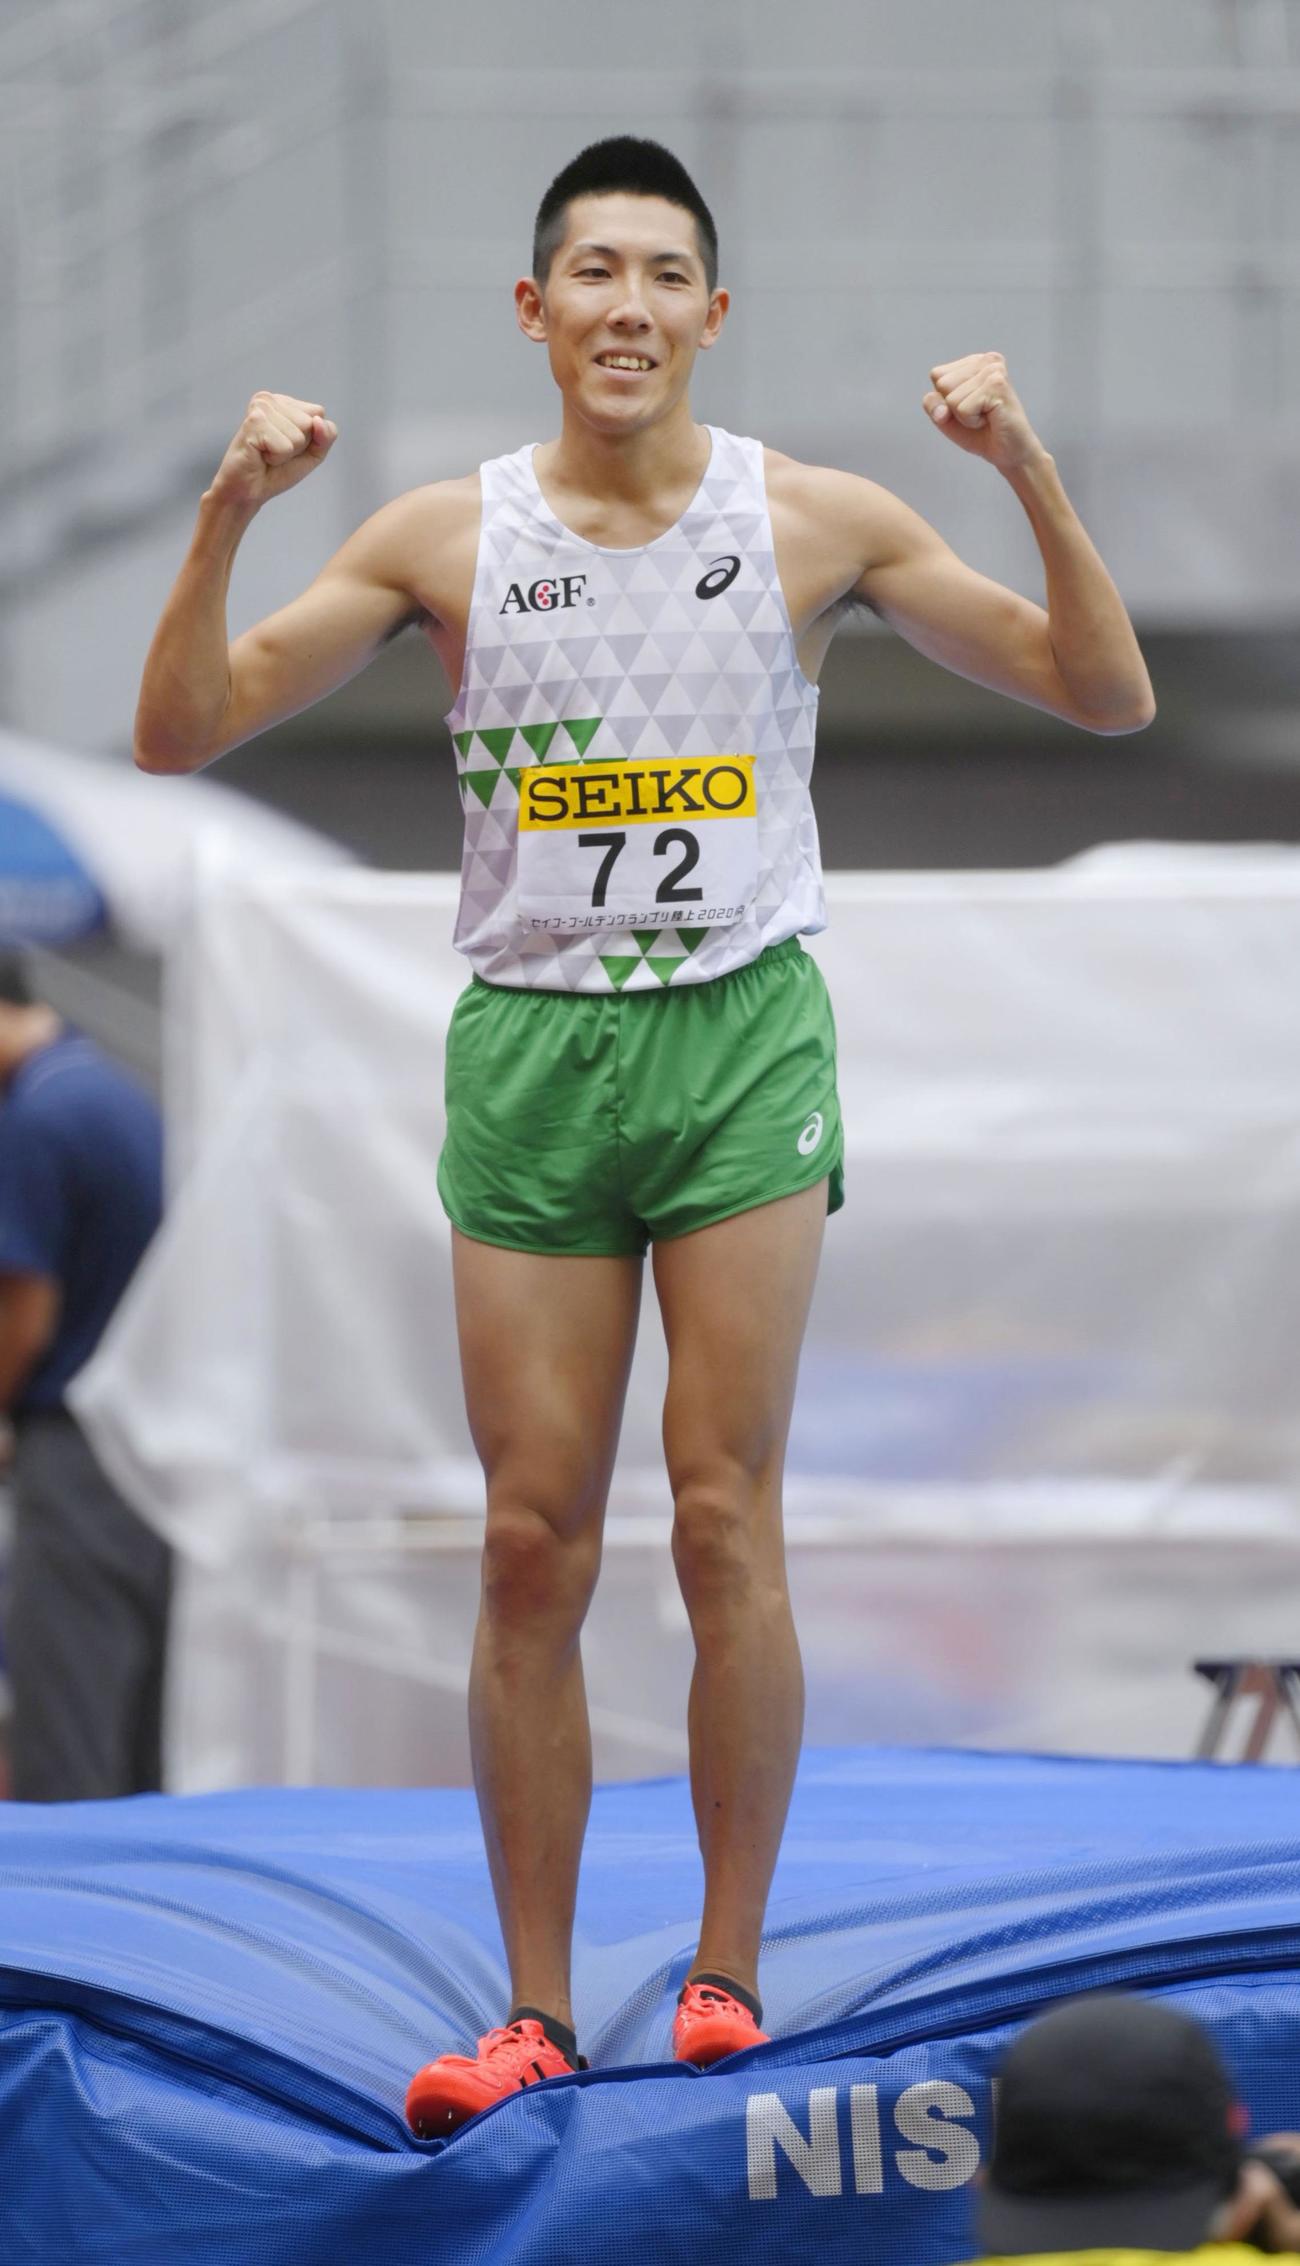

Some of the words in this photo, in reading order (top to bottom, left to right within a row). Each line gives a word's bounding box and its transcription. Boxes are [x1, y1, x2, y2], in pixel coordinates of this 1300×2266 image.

[528, 766, 748, 821] SEIKO
[578, 828, 703, 908] 72
[747, 2078, 999, 2199] NIS
